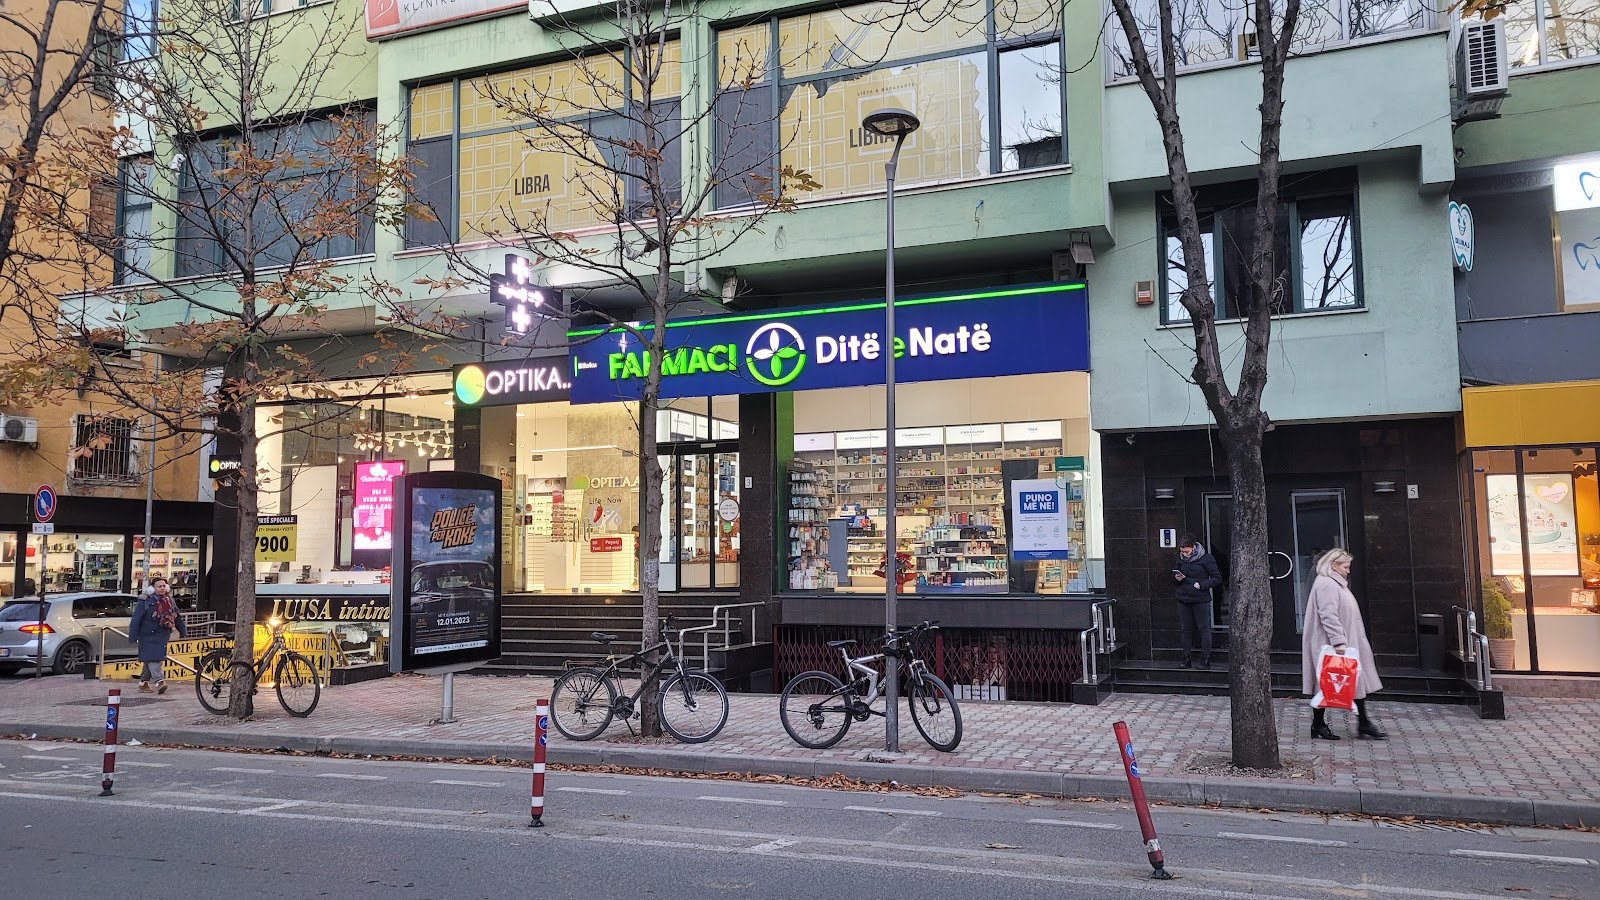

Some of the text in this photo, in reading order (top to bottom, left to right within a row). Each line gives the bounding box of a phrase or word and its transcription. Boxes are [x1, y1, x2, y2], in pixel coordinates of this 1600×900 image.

[403, 0, 456, 13] KLINI
[514, 174, 550, 196] LIBRA
[816, 332, 880, 364] Ditë
[909, 322, 992, 357] Natë
[485, 366, 571, 395] OPTIKA.
[1023, 501, 1055, 511] ME NE!
[1025, 493, 1052, 503] PUNO
[430, 503, 475, 532] POLICË
[442, 522, 477, 549] KOKË
[272, 598, 332, 620] LUISA
[436, 616, 470, 626] 12.01.2023
[168, 642, 194, 655] AME
[1327, 672, 1351, 694] V
